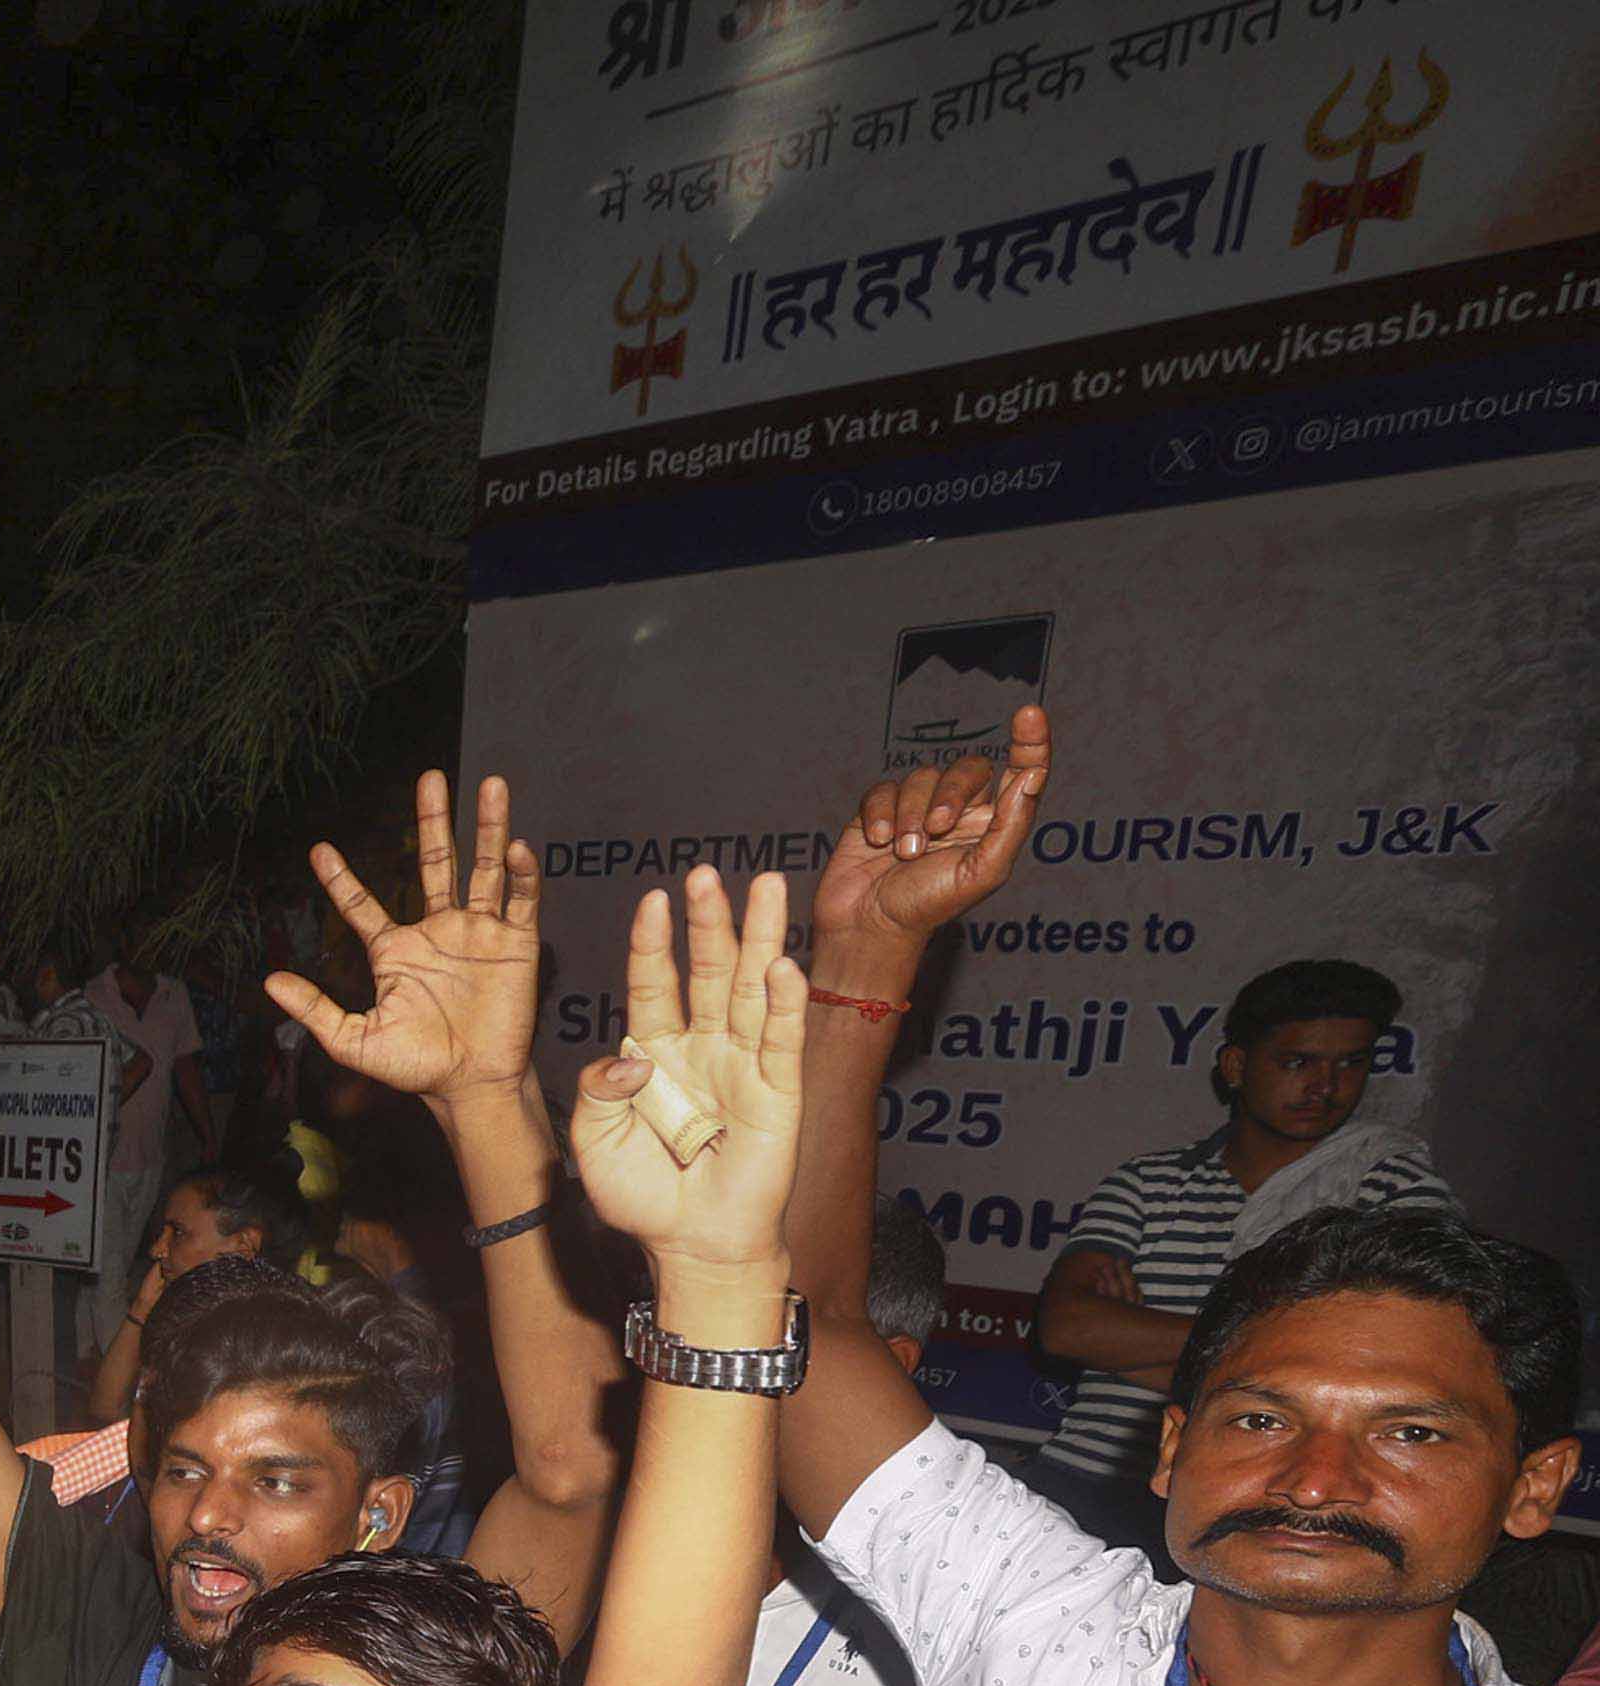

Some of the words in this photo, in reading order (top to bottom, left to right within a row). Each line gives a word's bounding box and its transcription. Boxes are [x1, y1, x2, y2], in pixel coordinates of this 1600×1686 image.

[850, 99, 920, 154] का
[930, 43, 1094, 142] हार्दिक
[761, 258, 847, 352] हर
[853, 235, 944, 327] हर
[952, 156, 1216, 302] महादेव
[484, 478, 532, 509] For
[538, 455, 639, 498] Details
[646, 421, 816, 478] Regarding
[823, 407, 921, 448] Yatra
[953, 376, 1057, 427] Login
[1072, 365, 1126, 400] to:
[860, 459, 1064, 518] 18008908457
[543, 832, 836, 880] DEPARTMEN
[1033, 810, 1315, 869] OURISM,
[1337, 801, 1502, 858] J&K
[1142, 914, 1197, 955] to
[558, 992, 628, 1044] Sh
[31, 1093, 96, 1119] CORPORATION
